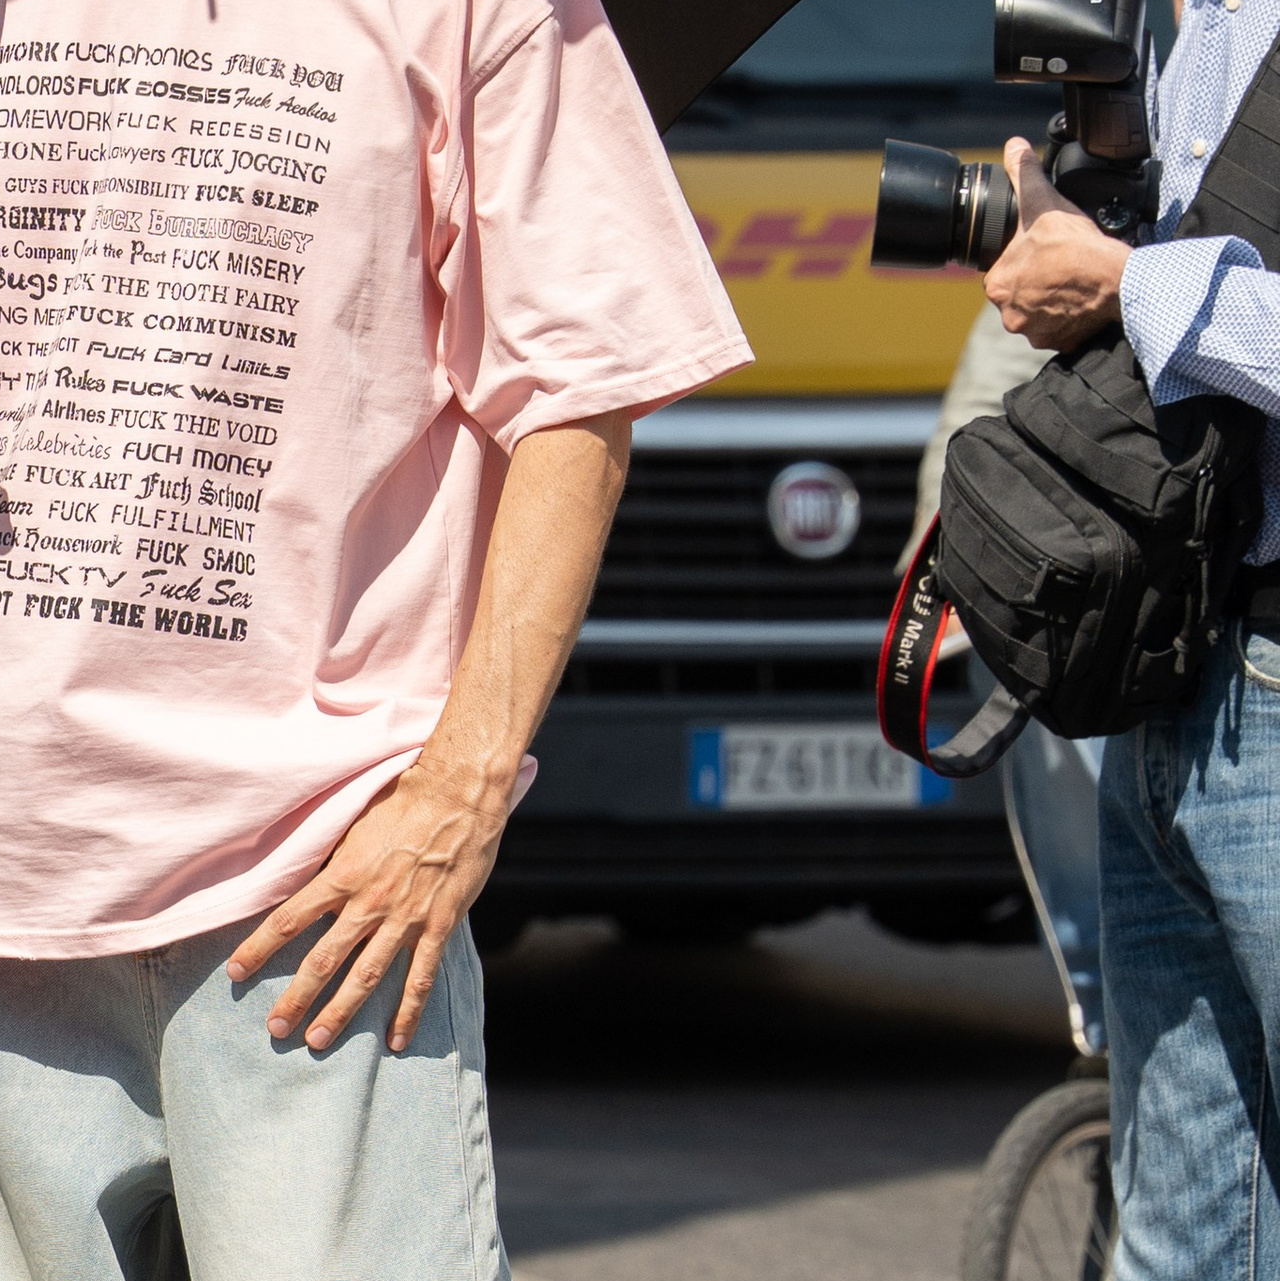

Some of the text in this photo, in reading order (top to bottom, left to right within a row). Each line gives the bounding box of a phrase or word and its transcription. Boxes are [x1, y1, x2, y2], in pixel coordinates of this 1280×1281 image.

[0, 41, 60, 65] WORK
[65, 42, 116, 64] FUCK
[221, 53, 285, 81] FUCK
[289, 63, 345, 94] YOU
[78, 77, 133, 98] FUCK
[233, 87, 274, 109] Fuck
[117, 111, 178, 134] FUCK
[190, 118, 332, 155] RECESSION
[66, 141, 107, 162] Fuck
[171, 146, 225, 169] FUCK
[224, 149, 328, 185] JOGGING
[5, 177, 48, 195] GUYS
[52, 179, 90, 196] FUCK
[195, 184, 246, 205] FUCK
[251, 188, 320, 218] SLEEP
[14, 240, 79, 265] Company
[103, 242, 124, 260] the
[130, 240, 167, 266] Past
[172, 248, 220, 272] FUCK
[226, 251, 306, 286] MISERY
[102, 274, 150, 299] THE
[157, 281, 229, 304] TOOTH
[234, 287, 300, 317] FAIRY
[66, 304, 135, 328] FUCK
[143, 313, 298, 349] COMMUNISM
[27, 341, 50, 358] THE
[55, 365, 106, 394] Rules
[112, 379, 185, 400] FUCK
[190, 385, 285, 415] WASTE
[108, 408, 169, 431] FUCK
[173, 413, 221, 438] THE
[226, 420, 278, 447] VOID
[192, 448, 273, 479] MONEY
[25, 464, 87, 489] FUCK
[89, 471, 133, 491] ART
[200, 477, 264, 515] School
[49, 500, 101, 524] FUCK
[111, 504, 256, 544] FULFILLMENT
[23, 526, 124, 556] Housework
[136, 537, 190, 568] FUCK
[78, 565, 128, 588] TV
[207, 578, 254, 610] Sex
[23, 593, 84, 621] FUCK
[90, 597, 147, 630] THE
[154, 605, 249, 643] WORLD
[895, 618, 925, 669] Mark
